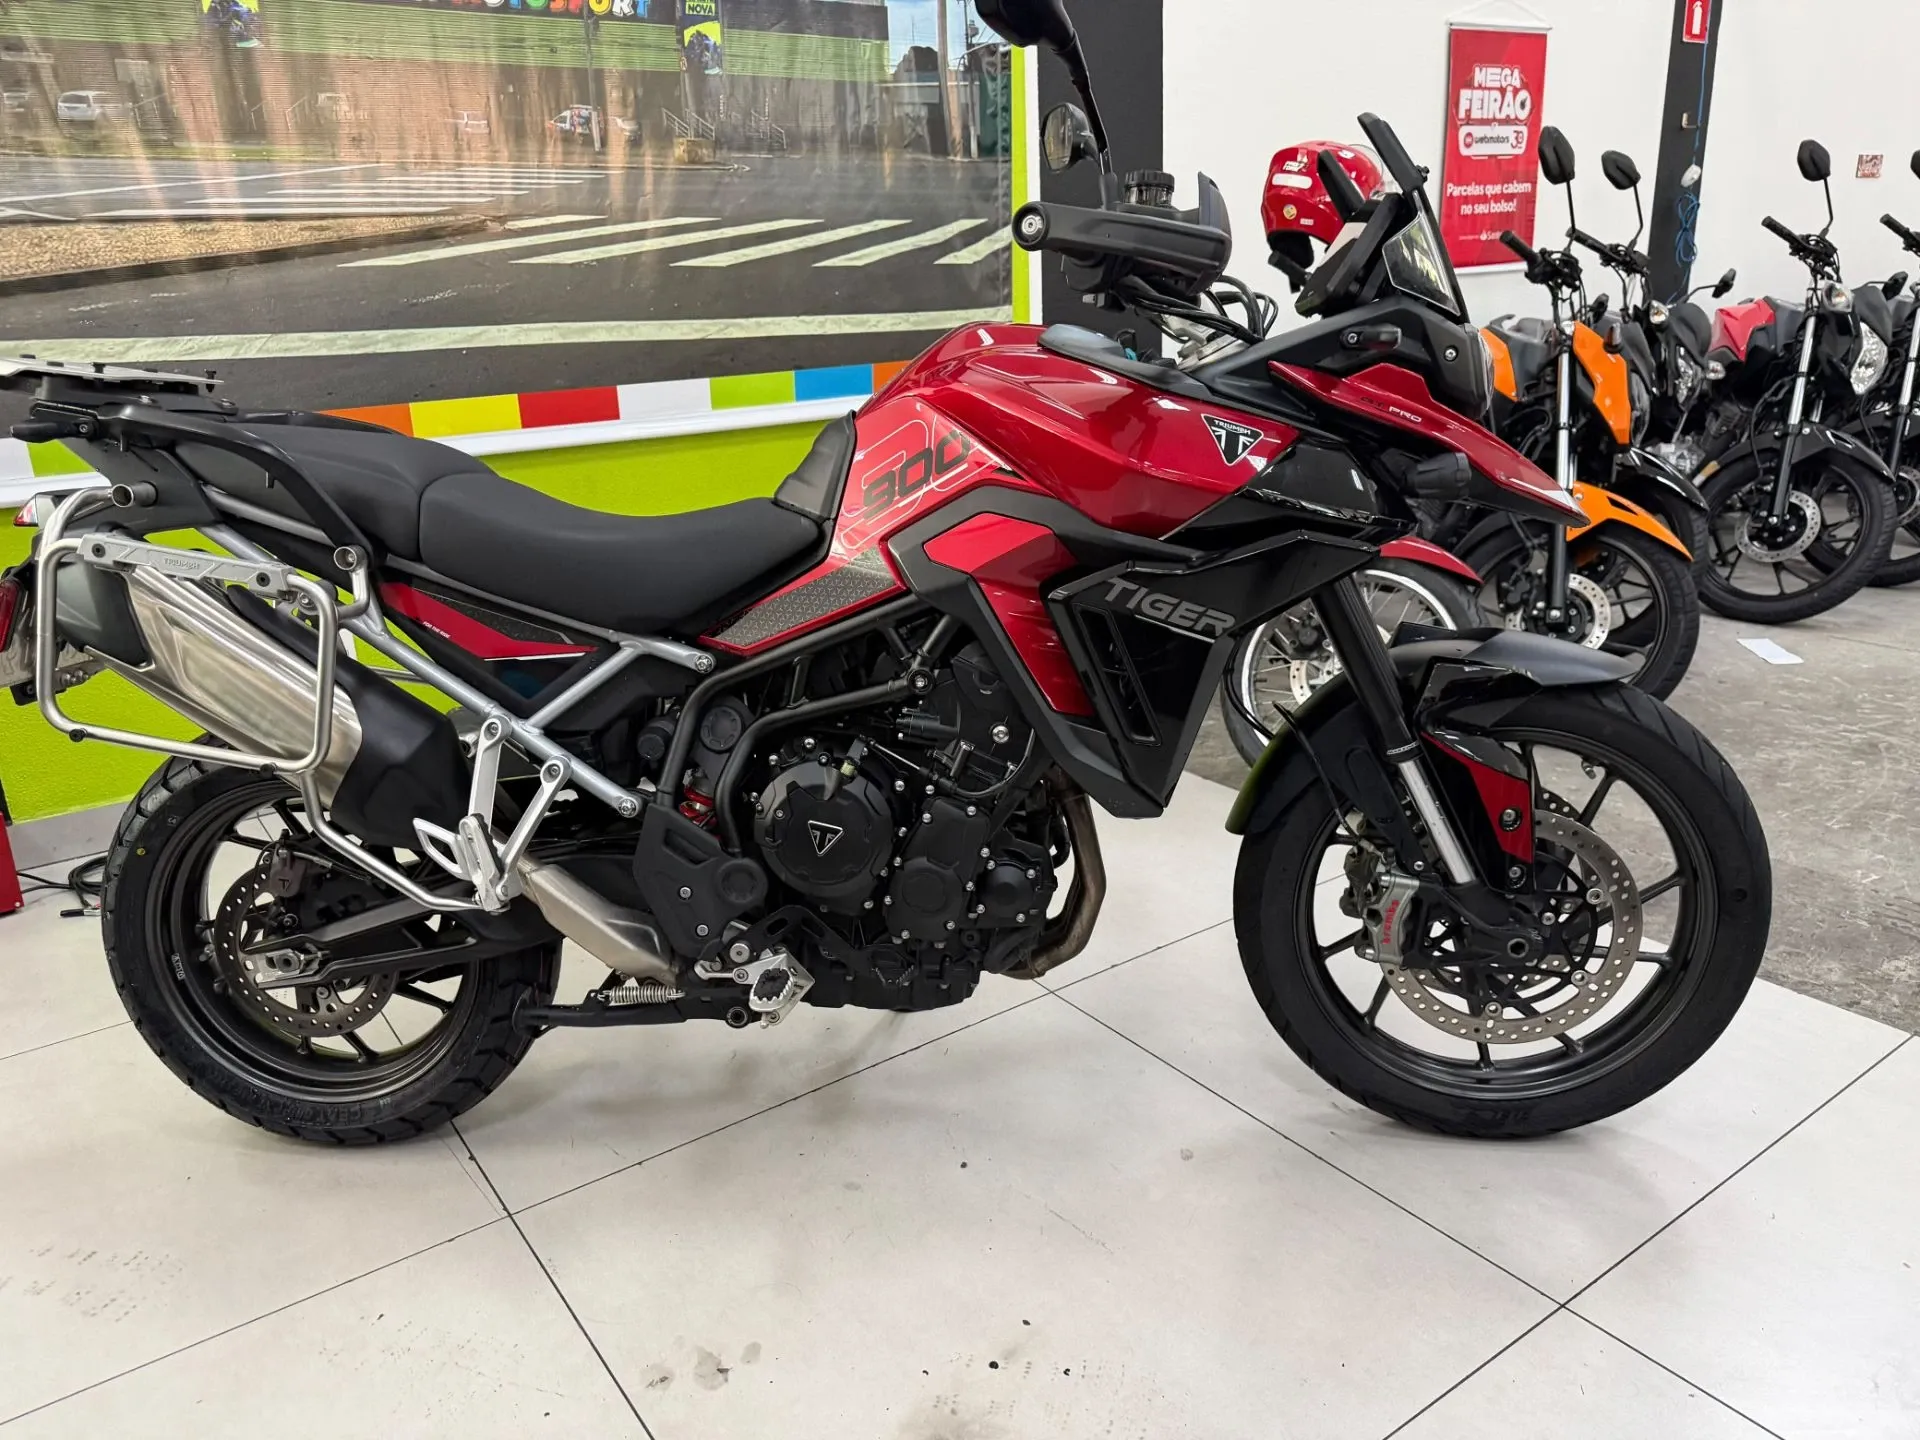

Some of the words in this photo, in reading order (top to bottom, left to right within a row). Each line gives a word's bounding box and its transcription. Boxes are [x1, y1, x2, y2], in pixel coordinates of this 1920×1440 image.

[688, 3, 714, 14] NOVA
[1474, 66, 1521, 88] MEGA
[1458, 86, 1532, 120] FEIRÃO
[1475, 134, 1510, 144] webmotors
[1447, 182, 1485, 196] Parcelas
[1485, 184, 1502, 198] que
[1502, 180, 1532, 193] cabem
[1460, 204, 1473, 215] no
[1473, 202, 1490, 214] seu
[1490, 199, 1517, 212] bolso!
[1388, 406, 1422, 423] PRO
[1213, 419, 1252, 436] TRIUMPH
[862, 428, 971, 520] 900
[1104, 576, 1236, 637] TIGER
[1382, 899, 1400, 944] brembo
